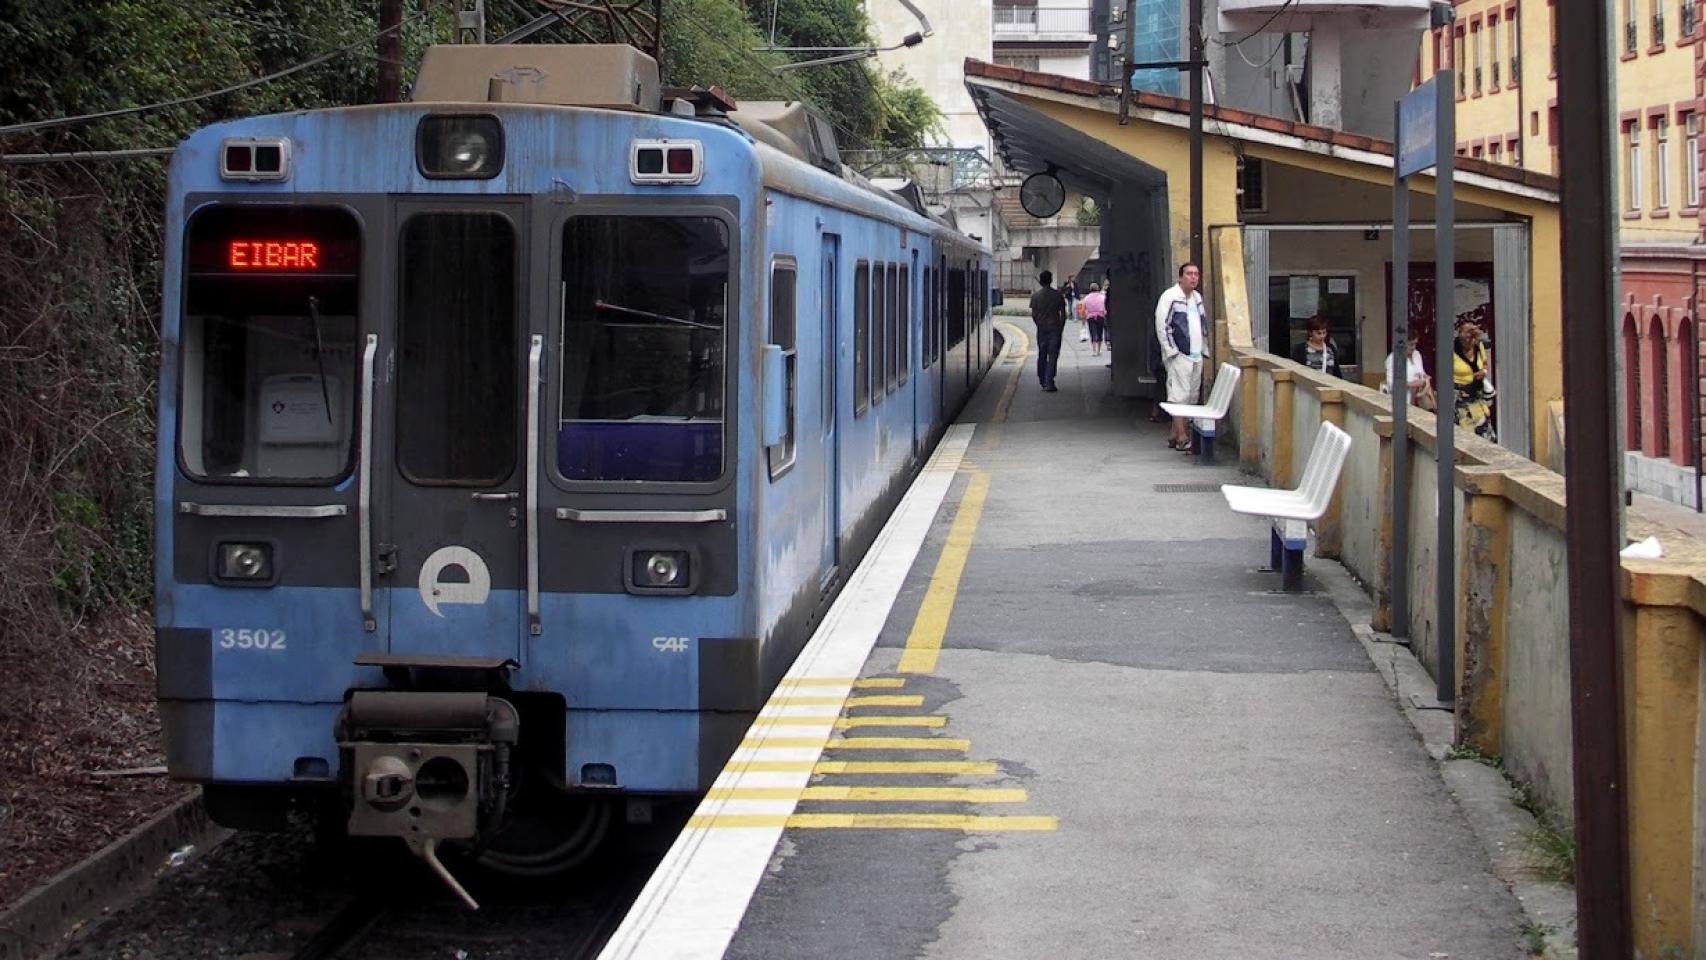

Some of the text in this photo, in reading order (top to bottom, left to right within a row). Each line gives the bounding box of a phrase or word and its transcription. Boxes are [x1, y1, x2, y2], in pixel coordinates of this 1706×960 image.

[231, 242, 317, 267] EIBAR
[220, 628, 287, 650] 3502
[652, 636, 689, 653] CAF
